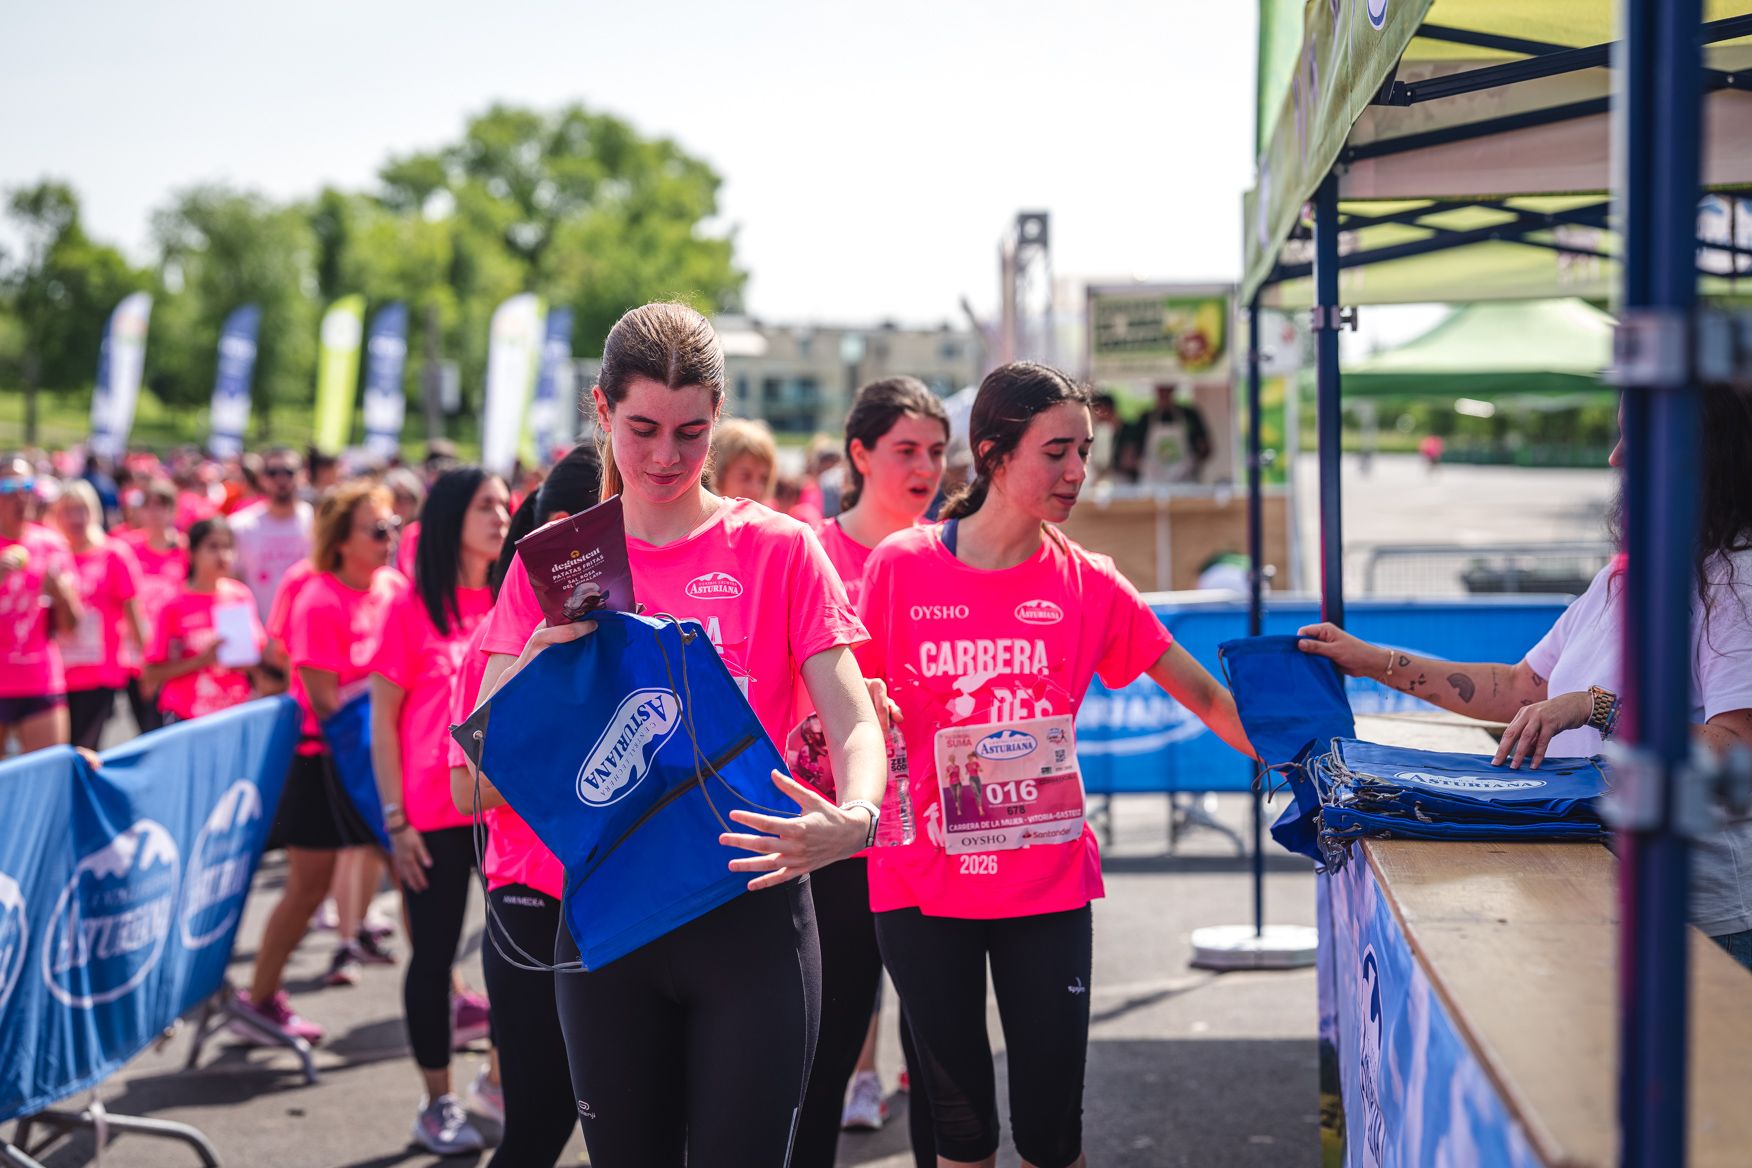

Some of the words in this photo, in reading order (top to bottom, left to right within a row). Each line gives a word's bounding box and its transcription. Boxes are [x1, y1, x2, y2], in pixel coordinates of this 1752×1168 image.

[552, 566, 582, 580] PATATAS
[582, 554, 604, 568] FRITAS
[690, 583, 739, 595] ASTURIANA
[910, 604, 970, 621] OYSHO
[583, 695, 667, 790] ASTURIANA
[981, 741, 1033, 755] ASTURIANA
[1409, 774, 1533, 788] ASTURIANA
[986, 780, 1038, 804] 016
[949, 823, 980, 832] CARRERA
[981, 821, 991, 829] DE
[961, 834, 1007, 847] OYSHO
[1033, 827, 1072, 838] Santander
[960, 854, 998, 874] 2026
